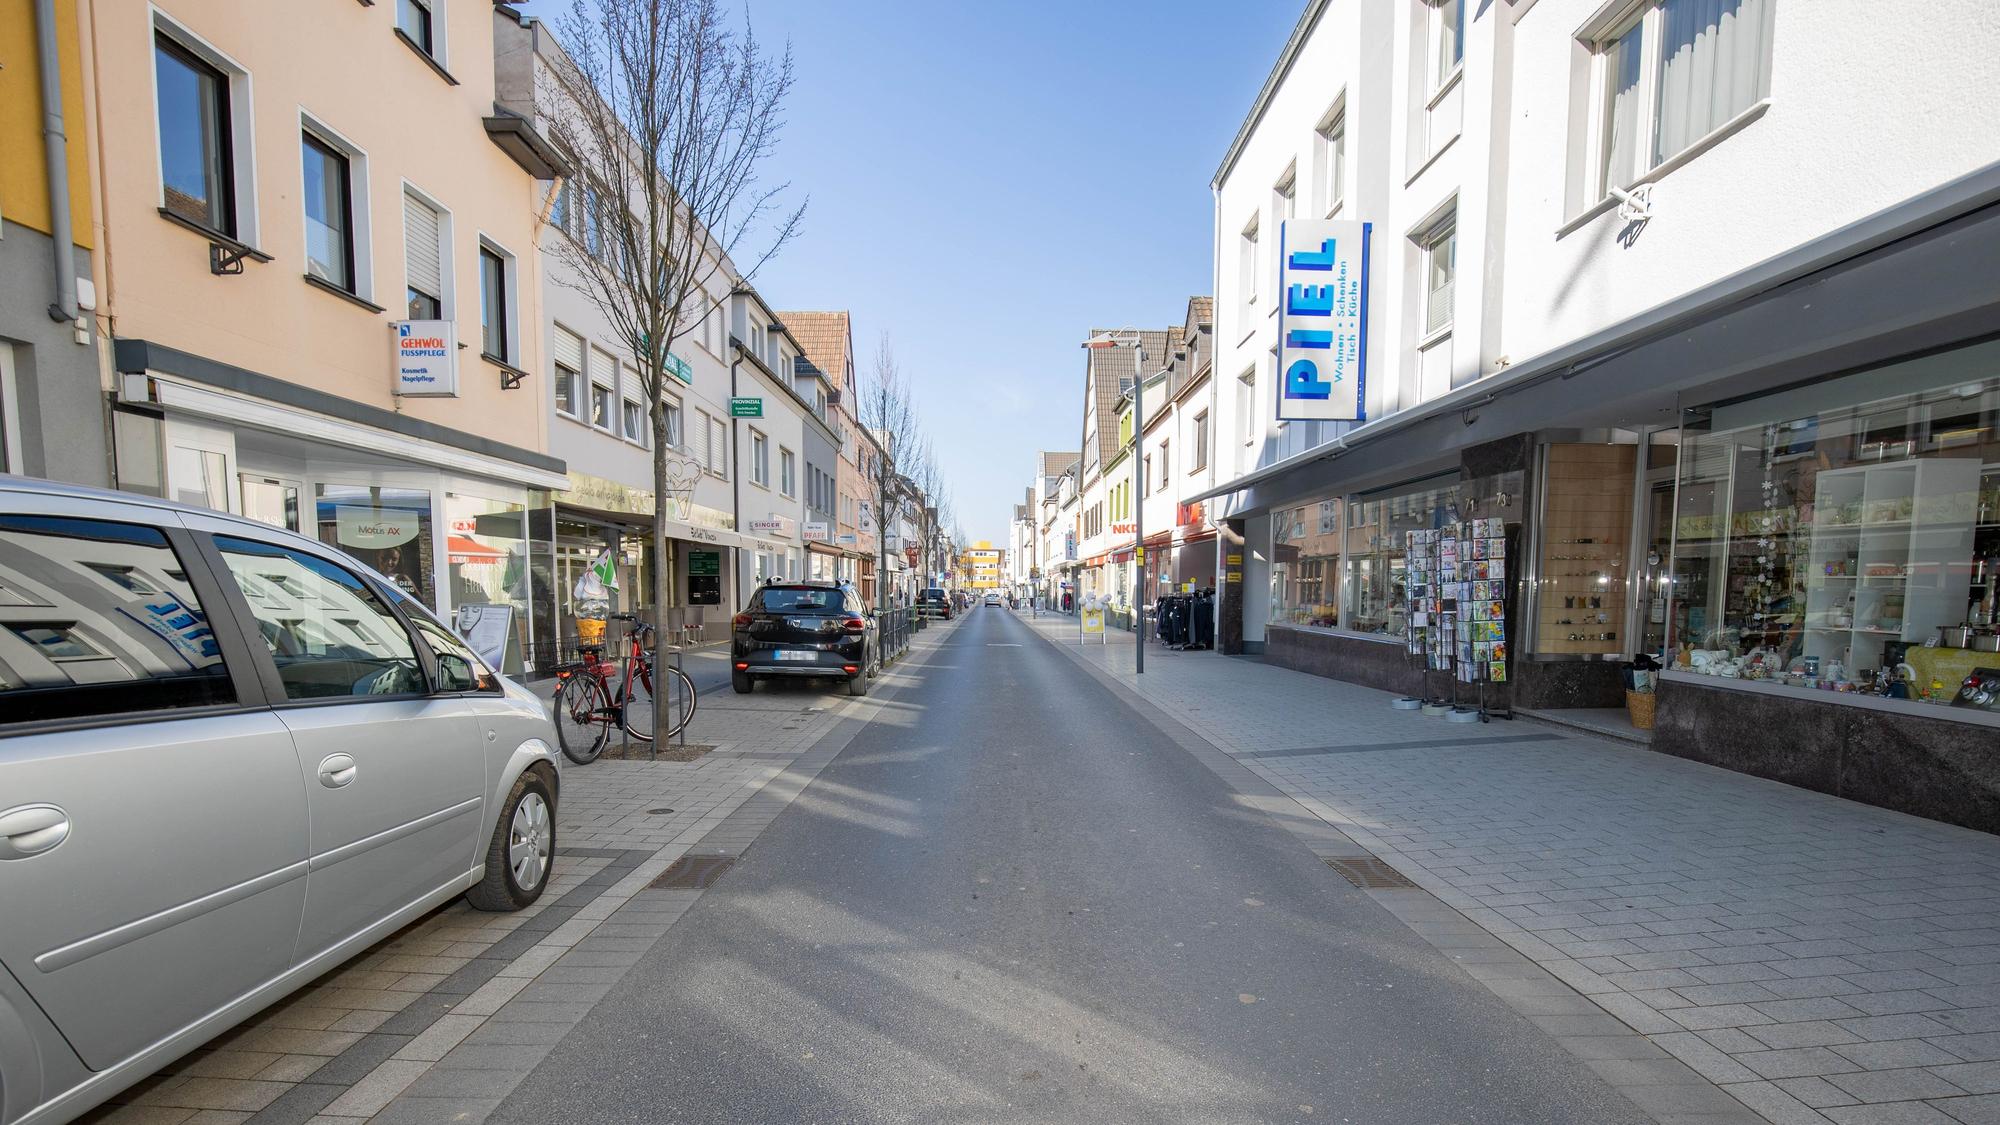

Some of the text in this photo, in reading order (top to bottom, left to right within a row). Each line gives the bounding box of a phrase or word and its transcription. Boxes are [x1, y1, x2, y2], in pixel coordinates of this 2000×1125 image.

[1285, 238, 1336, 399] PIEL
[1334, 260, 1348, 383] Wohnen Schenken
[1346, 280, 1358, 363] Tisch Küche
[401, 337, 445, 348] GEHWOL
[401, 349, 446, 357] FUSSPFLEGE
[402, 375, 435, 383] Nagelpflege
[387, 527, 400, 536] AX
